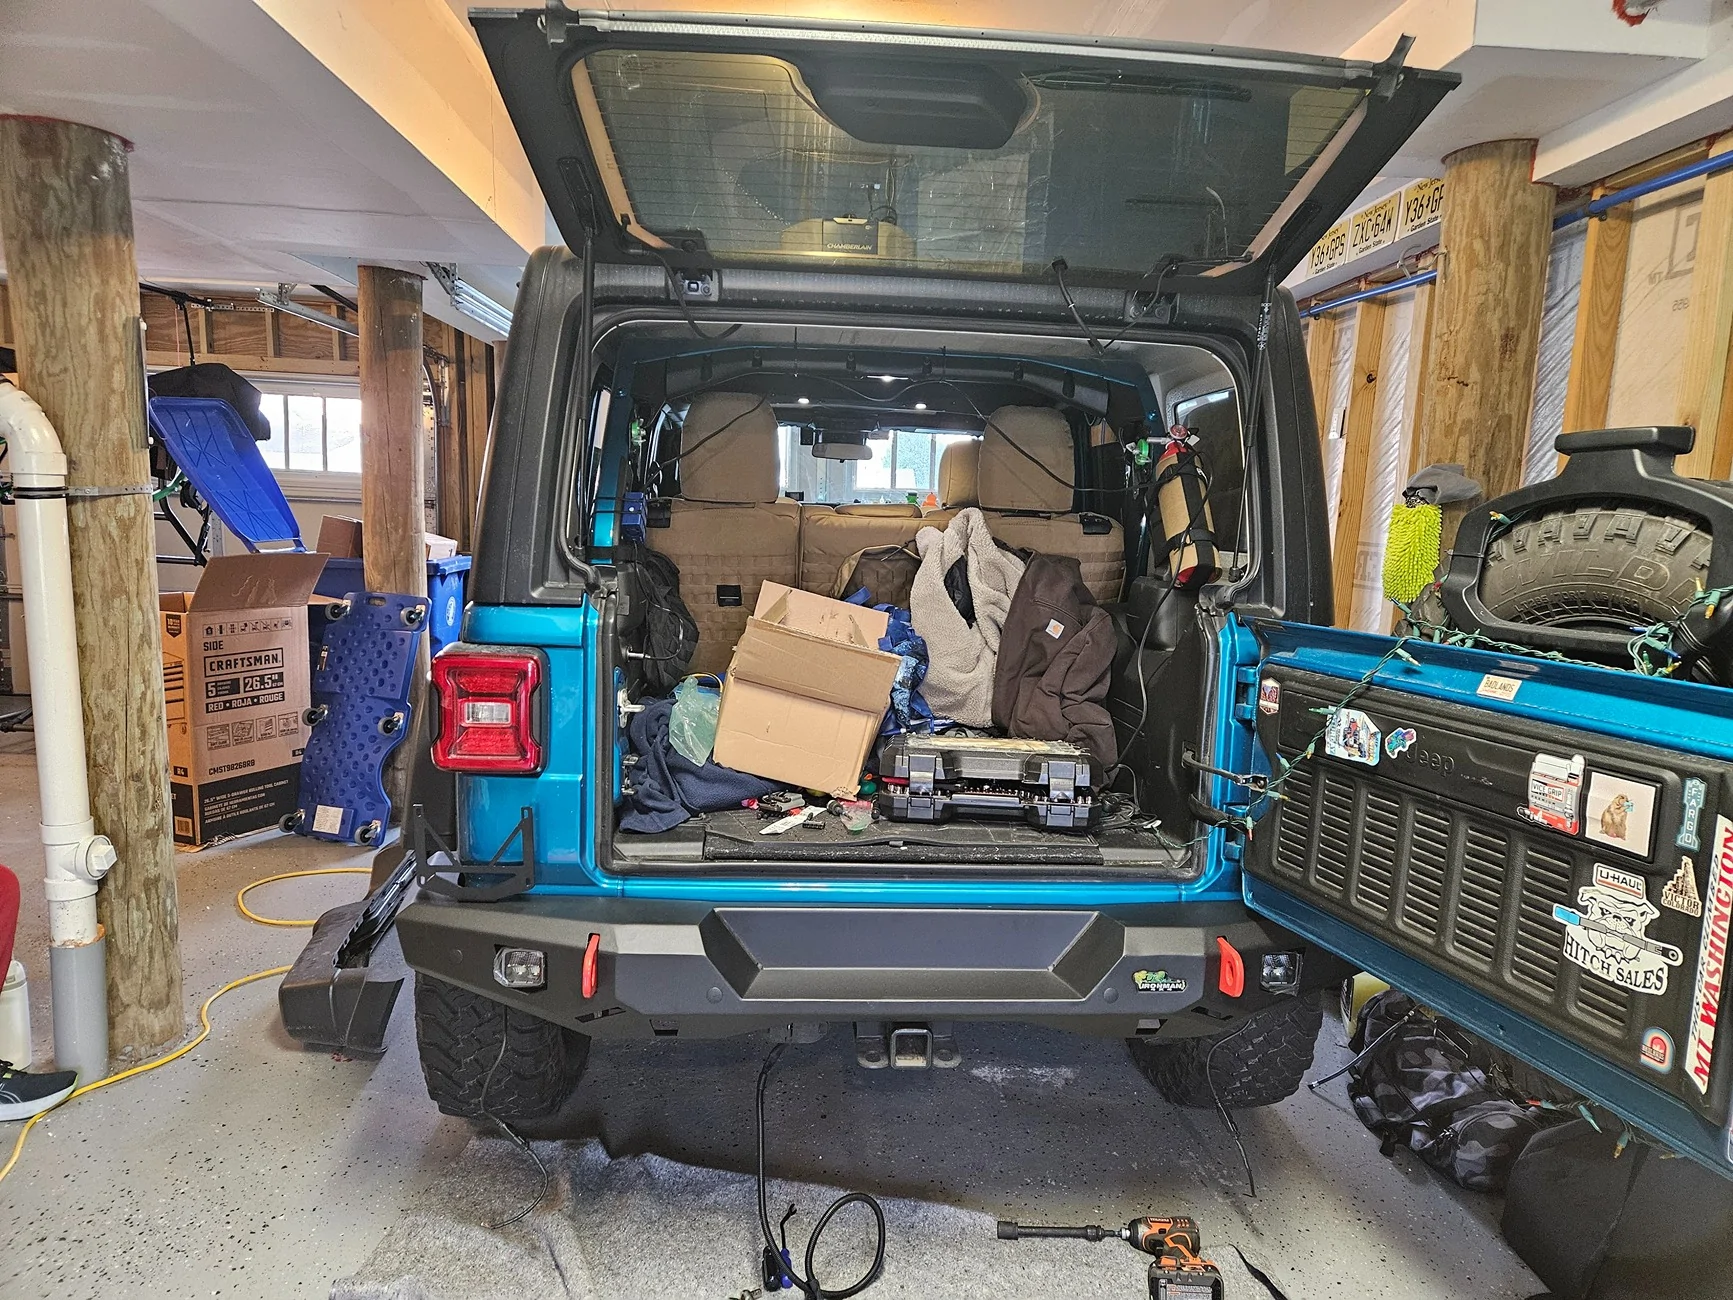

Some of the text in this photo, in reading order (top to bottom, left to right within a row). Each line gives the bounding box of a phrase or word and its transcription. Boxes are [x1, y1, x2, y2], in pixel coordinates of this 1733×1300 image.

[1411, 215, 1440, 232] Garden State
[1358, 239, 1383, 254] Garden State
[1314, 261, 1336, 275] Garden State
[203, 640, 224, 652] SIDE
[209, 653, 279, 672] CRAFTSMAN
[207, 682, 216, 697] 5
[1484, 680, 1514, 693] BADLANDS
[208, 692, 283, 712] RED ROJA ROUGE
[1533, 784, 1546, 793] VICE
[1547, 787, 1562, 798] GRIP
[1684, 787, 1699, 843] FARGO
[1600, 870, 1642, 891] U-HAUL
[1662, 898, 1699, 916] COLORADO
[1663, 890, 1700, 910] VICTOR
[1697, 955, 1705, 994] CAR
[1703, 853, 1719, 951] CLIMBED
[1700, 826, 1733, 1028] WASHINGTON
[1565, 932, 1664, 992] HITCH SALES
